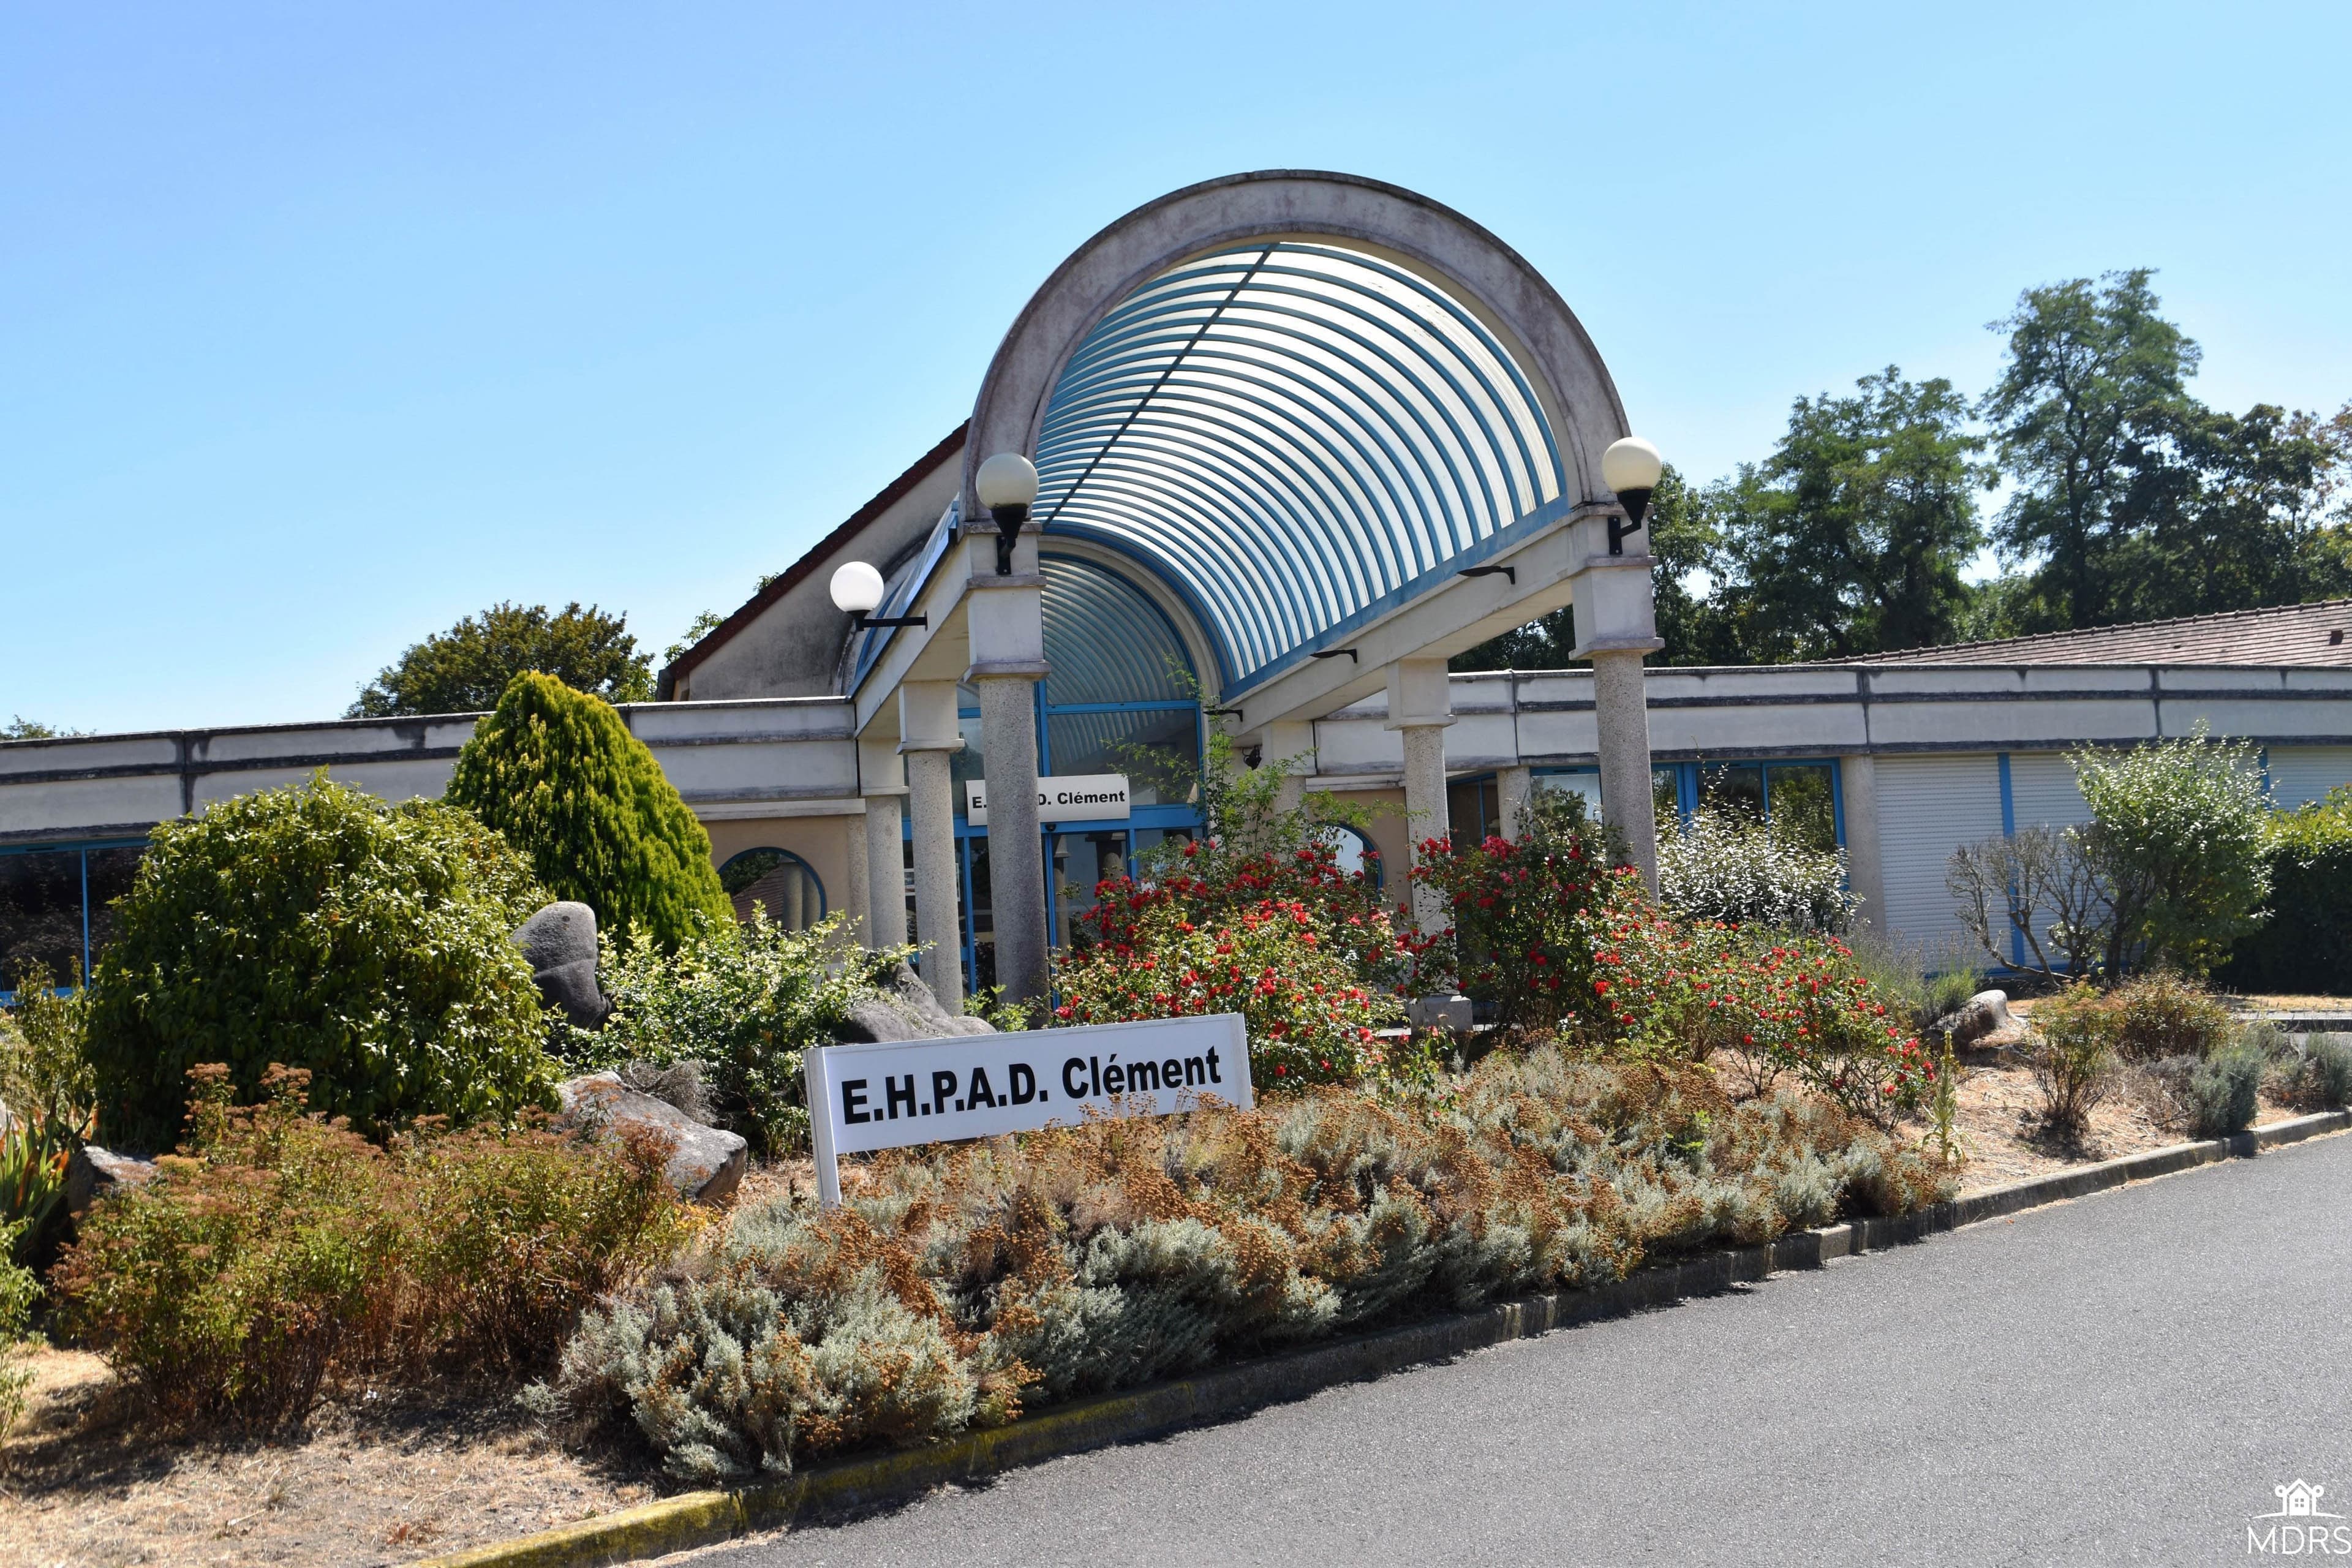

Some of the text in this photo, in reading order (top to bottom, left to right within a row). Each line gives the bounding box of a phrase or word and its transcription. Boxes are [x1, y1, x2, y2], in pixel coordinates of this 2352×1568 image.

[1057, 790, 1125, 805] Clément
[841, 1046, 1222, 1125] E.H.P.A.D. Clément
